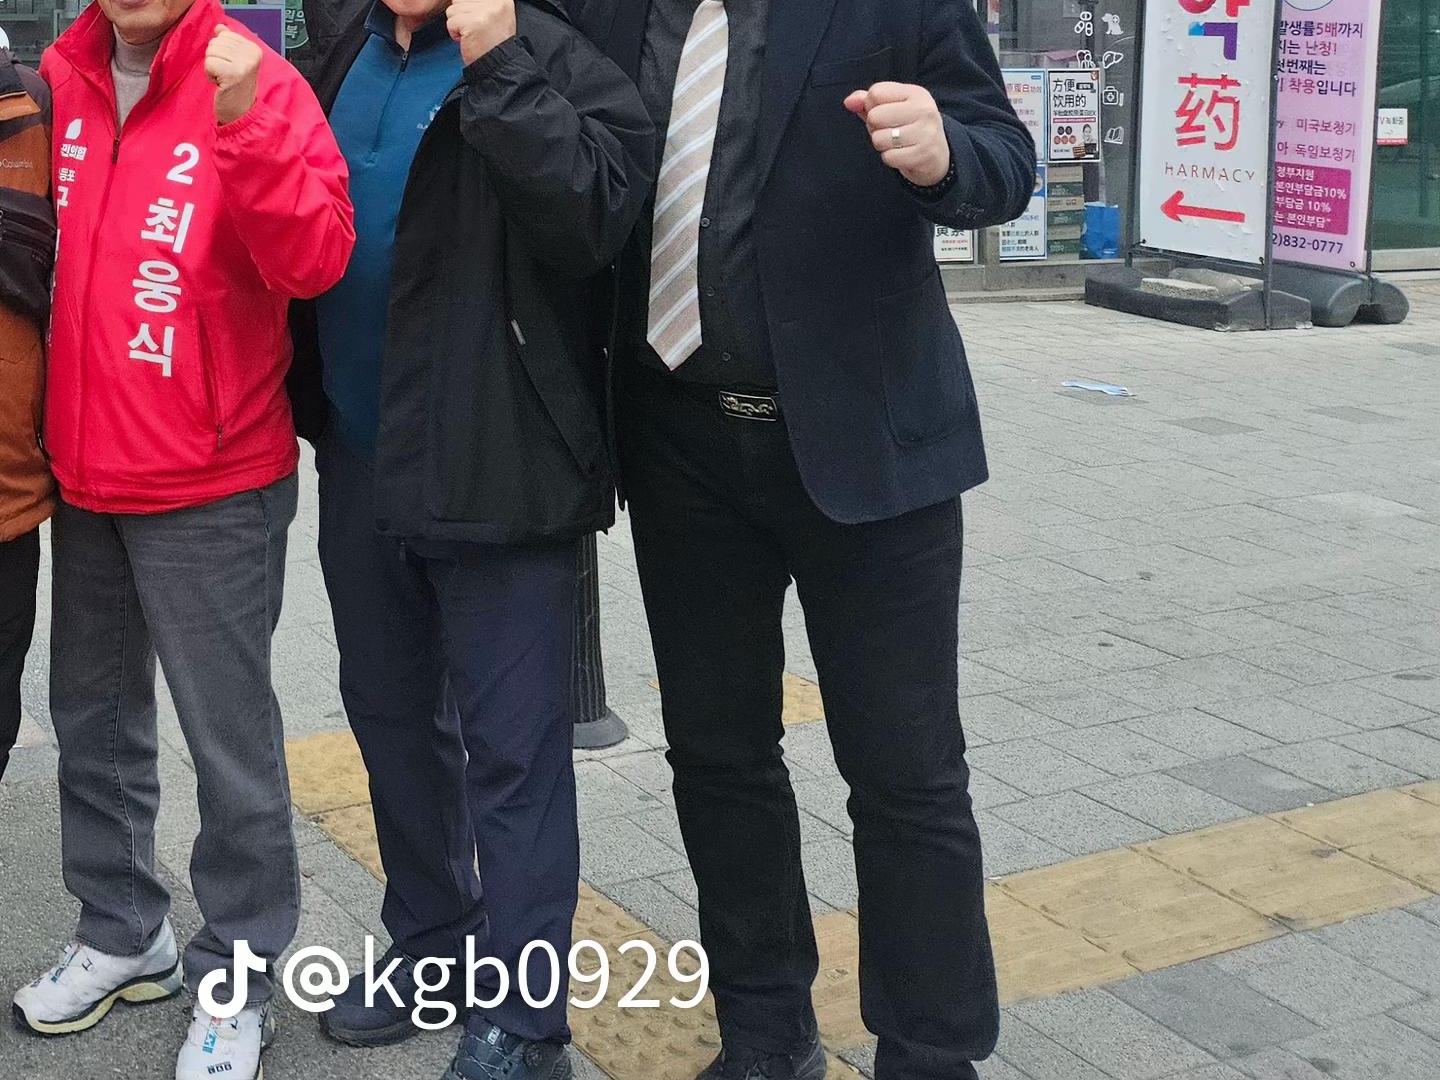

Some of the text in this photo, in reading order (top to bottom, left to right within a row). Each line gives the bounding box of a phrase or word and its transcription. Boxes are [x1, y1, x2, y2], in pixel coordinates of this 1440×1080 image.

[1174, 73, 1242, 152] 药
[1296, 118, 1357, 136] 미국보청기
[60, 143, 88, 161] 민의힘
[59, 167, 76, 183] 등포
[1164, 162, 1256, 184] HARMACY
[1308, 201, 1332, 213] 10%
[127, 143, 200, 378] 2 최웅식
